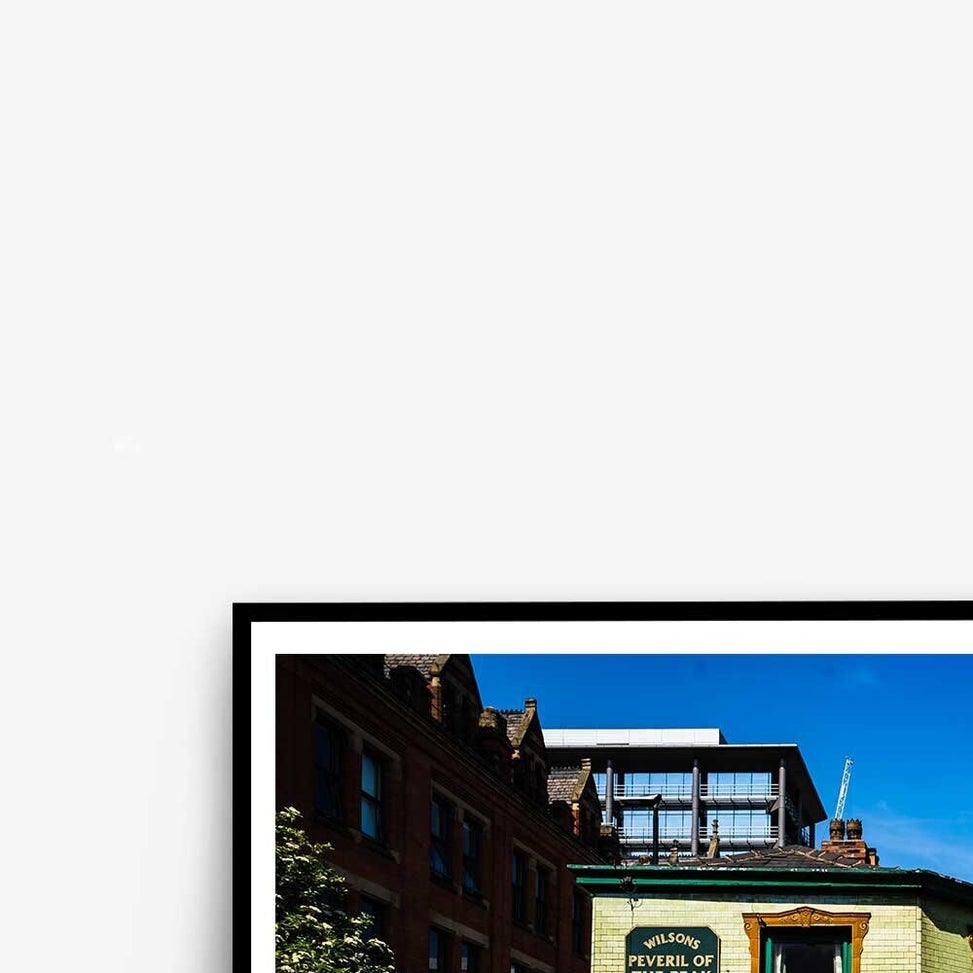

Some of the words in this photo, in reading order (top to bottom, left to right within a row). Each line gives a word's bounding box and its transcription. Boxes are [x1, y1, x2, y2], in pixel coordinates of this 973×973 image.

[643, 932, 701, 950] WILSONS
[628, 955, 689, 967] PEVERIL
[692, 955, 714, 967] OF
